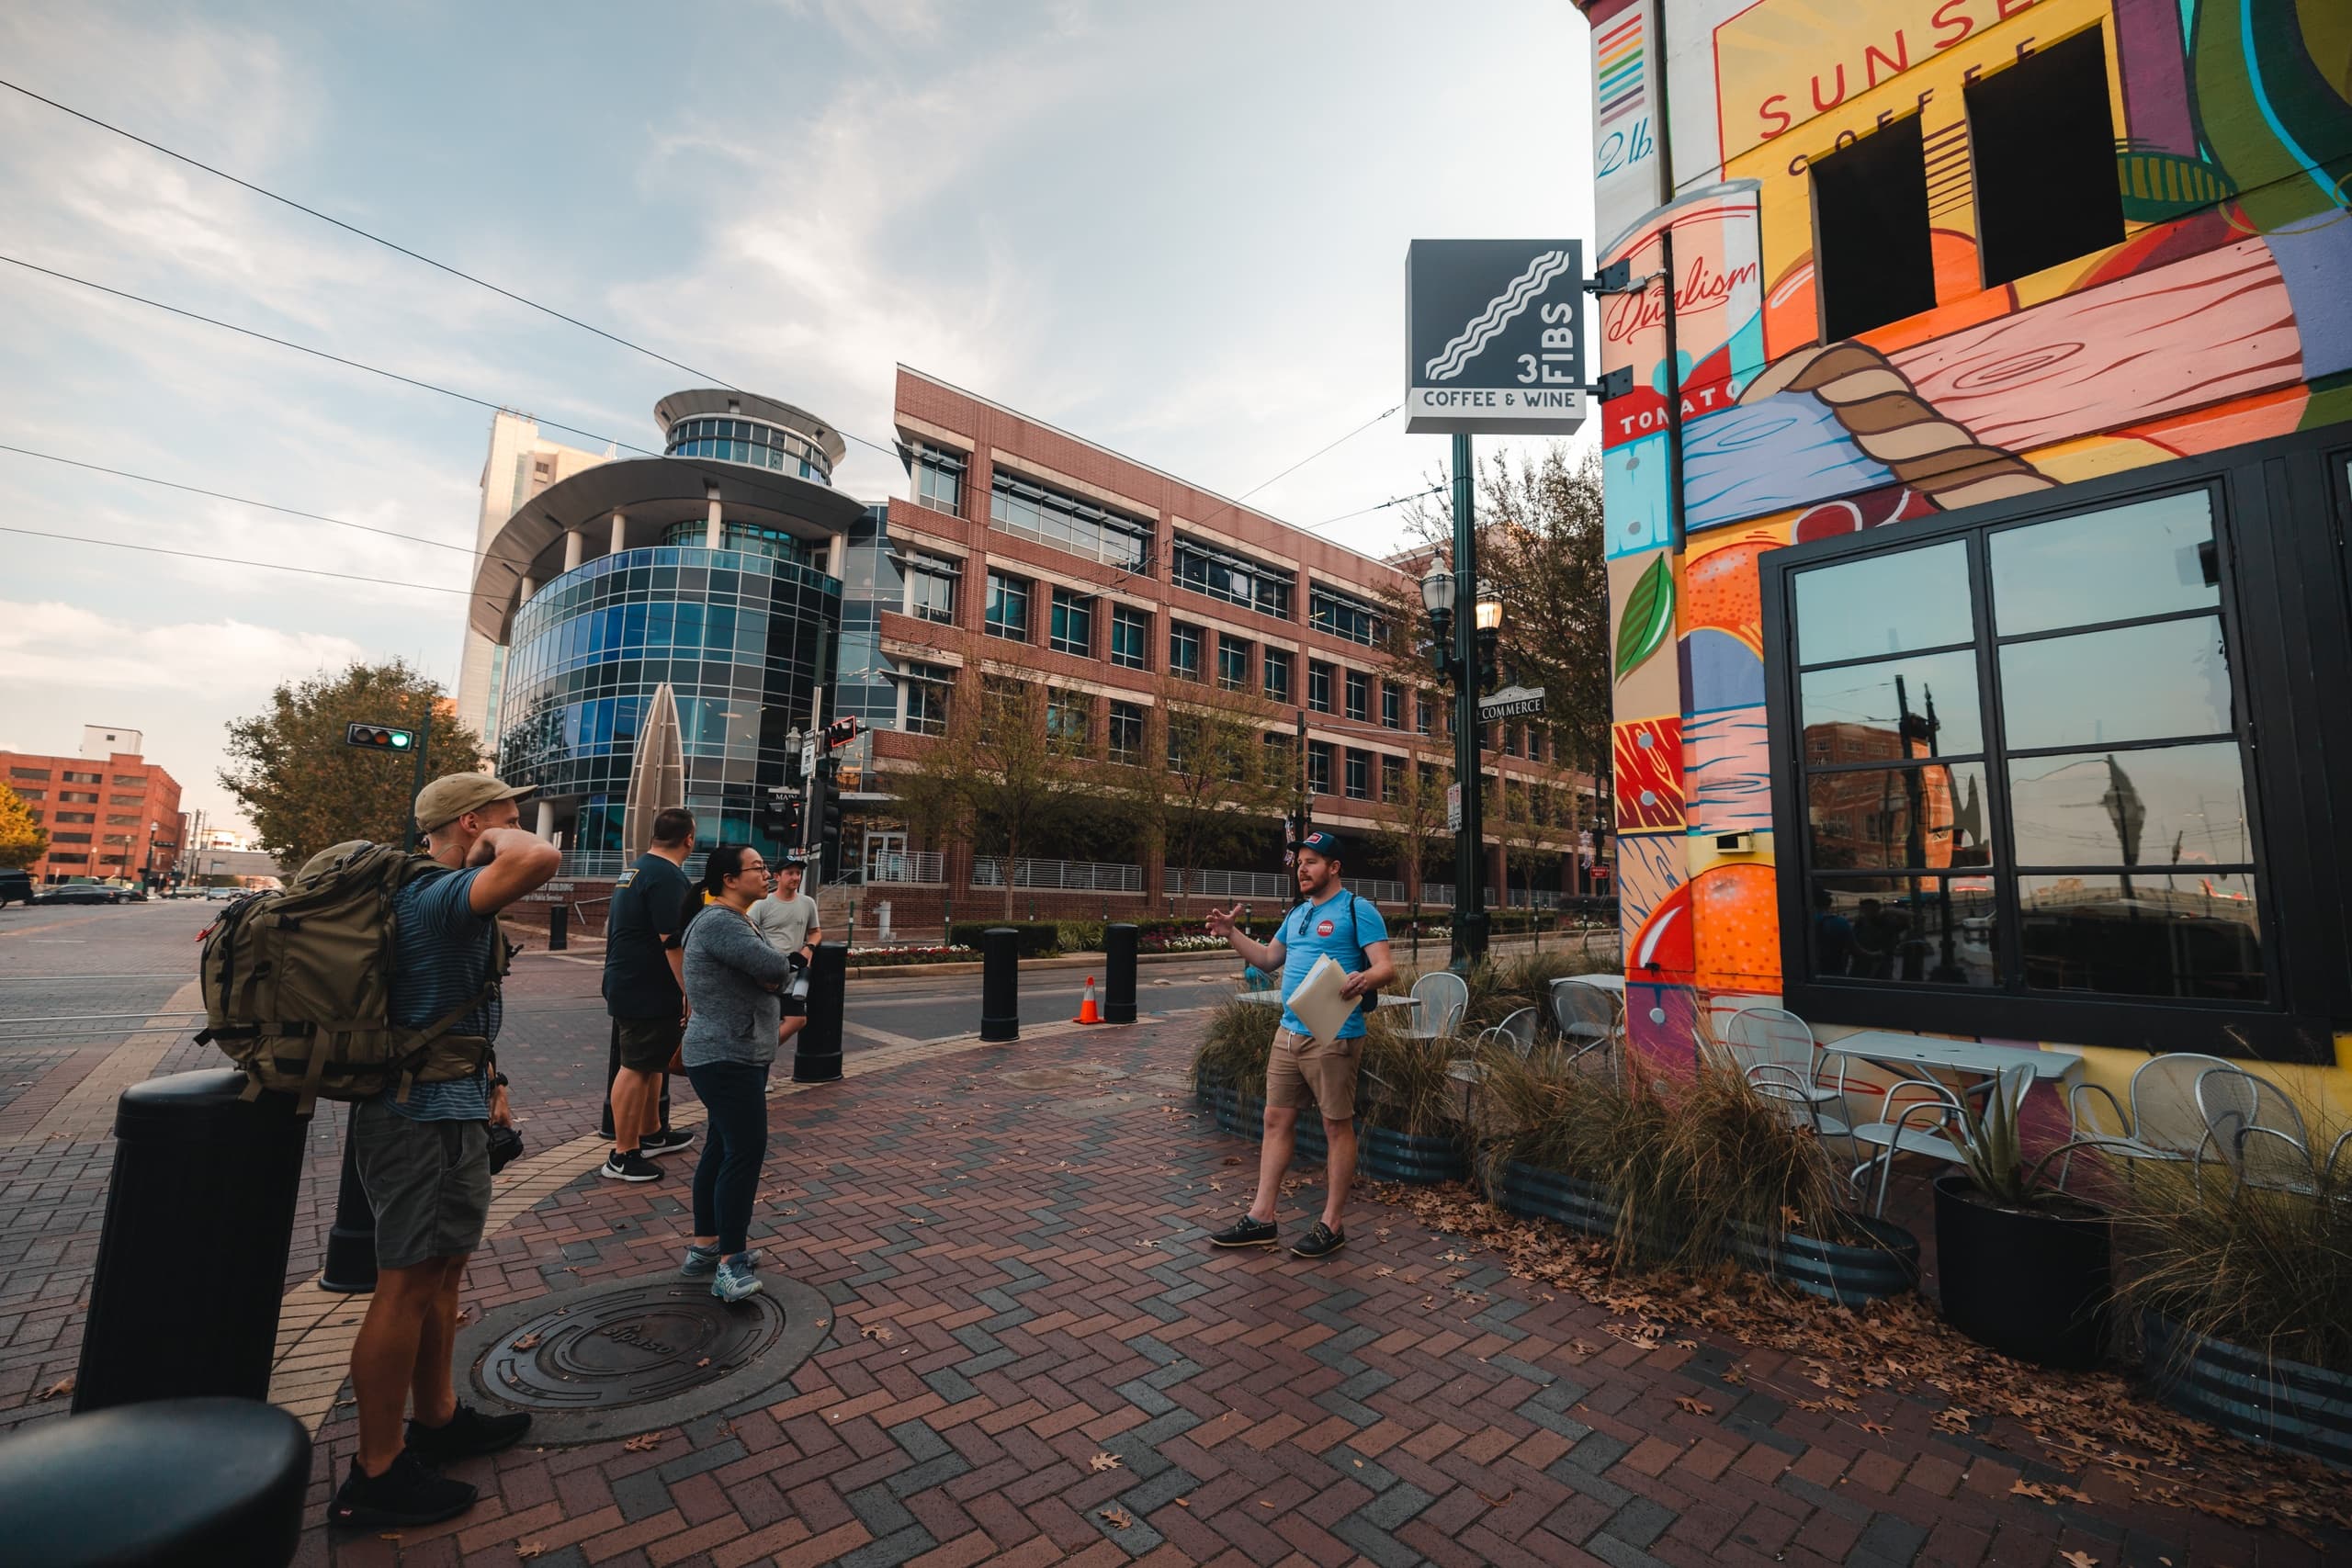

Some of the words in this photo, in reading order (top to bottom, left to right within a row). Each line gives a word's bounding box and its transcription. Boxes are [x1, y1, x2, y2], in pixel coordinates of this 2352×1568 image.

[1517, 354, 1538, 384] 3
[1541, 302, 1575, 384] FIBS
[1423, 391, 1497, 407] COFFEE
[1505, 393, 1515, 406] &
[1523, 391, 1576, 407] WINE
[1482, 699, 1541, 719] COMMERCE
